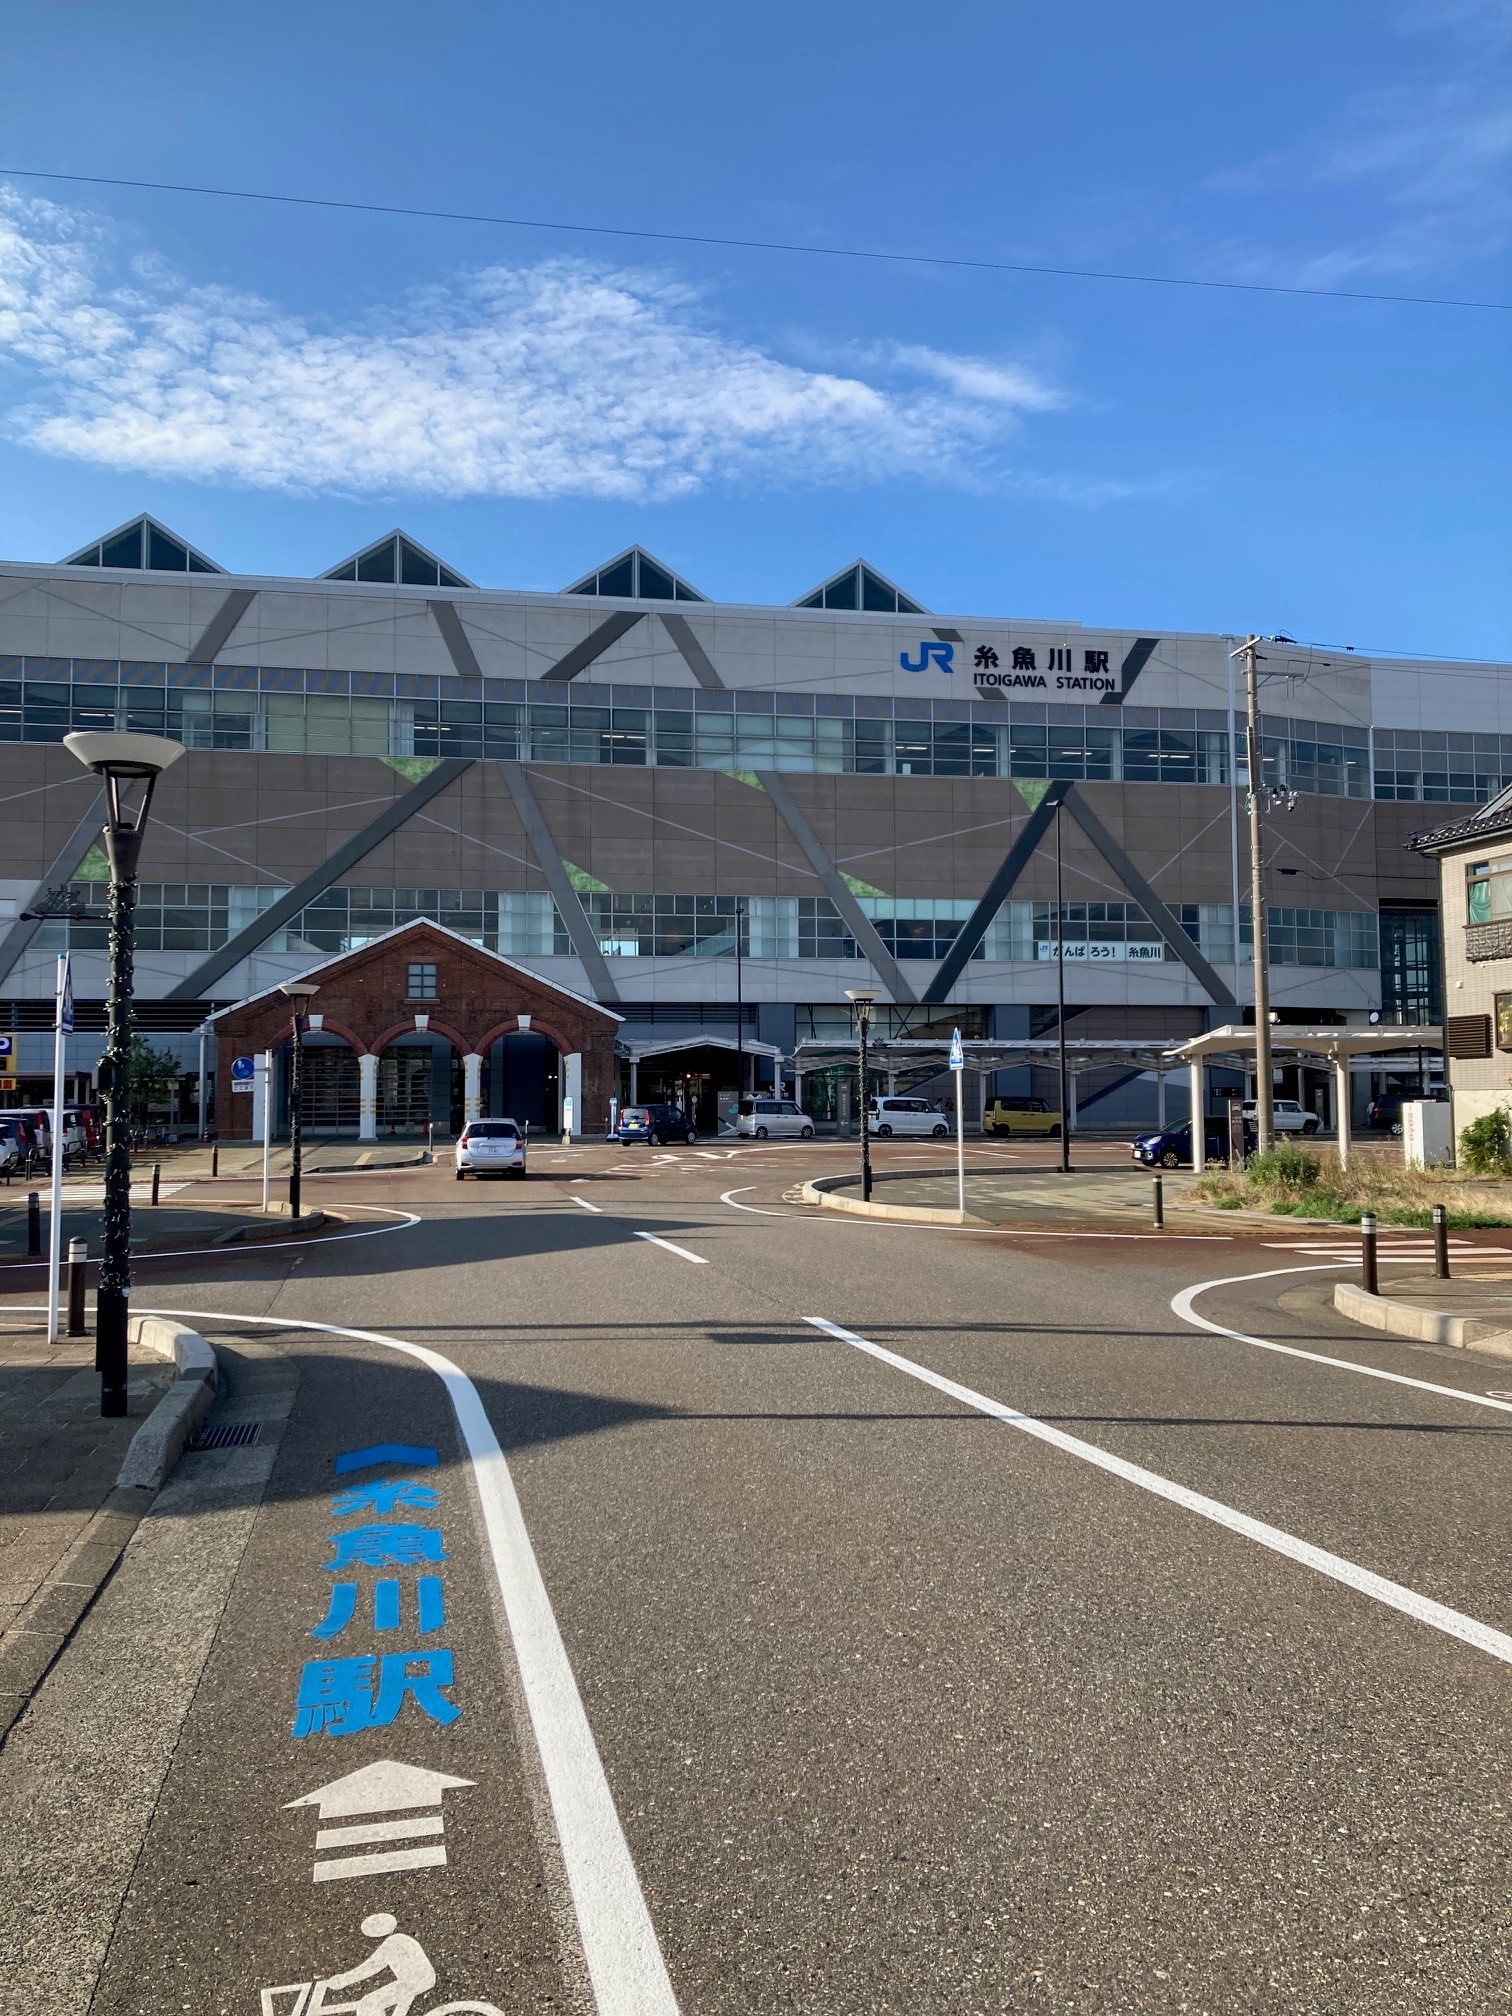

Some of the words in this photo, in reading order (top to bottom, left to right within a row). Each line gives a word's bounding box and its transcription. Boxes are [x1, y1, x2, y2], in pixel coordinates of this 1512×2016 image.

[900, 641, 954, 673] JR
[974, 645, 1109, 673] 糸魚川駅
[973, 673, 1047, 688] ITOIGAWA
[1056, 676, 1115, 690] STATION
[1129, 947, 1161, 959] 糸魚川
[291, 1478, 464, 1738] 糸魚川駅
